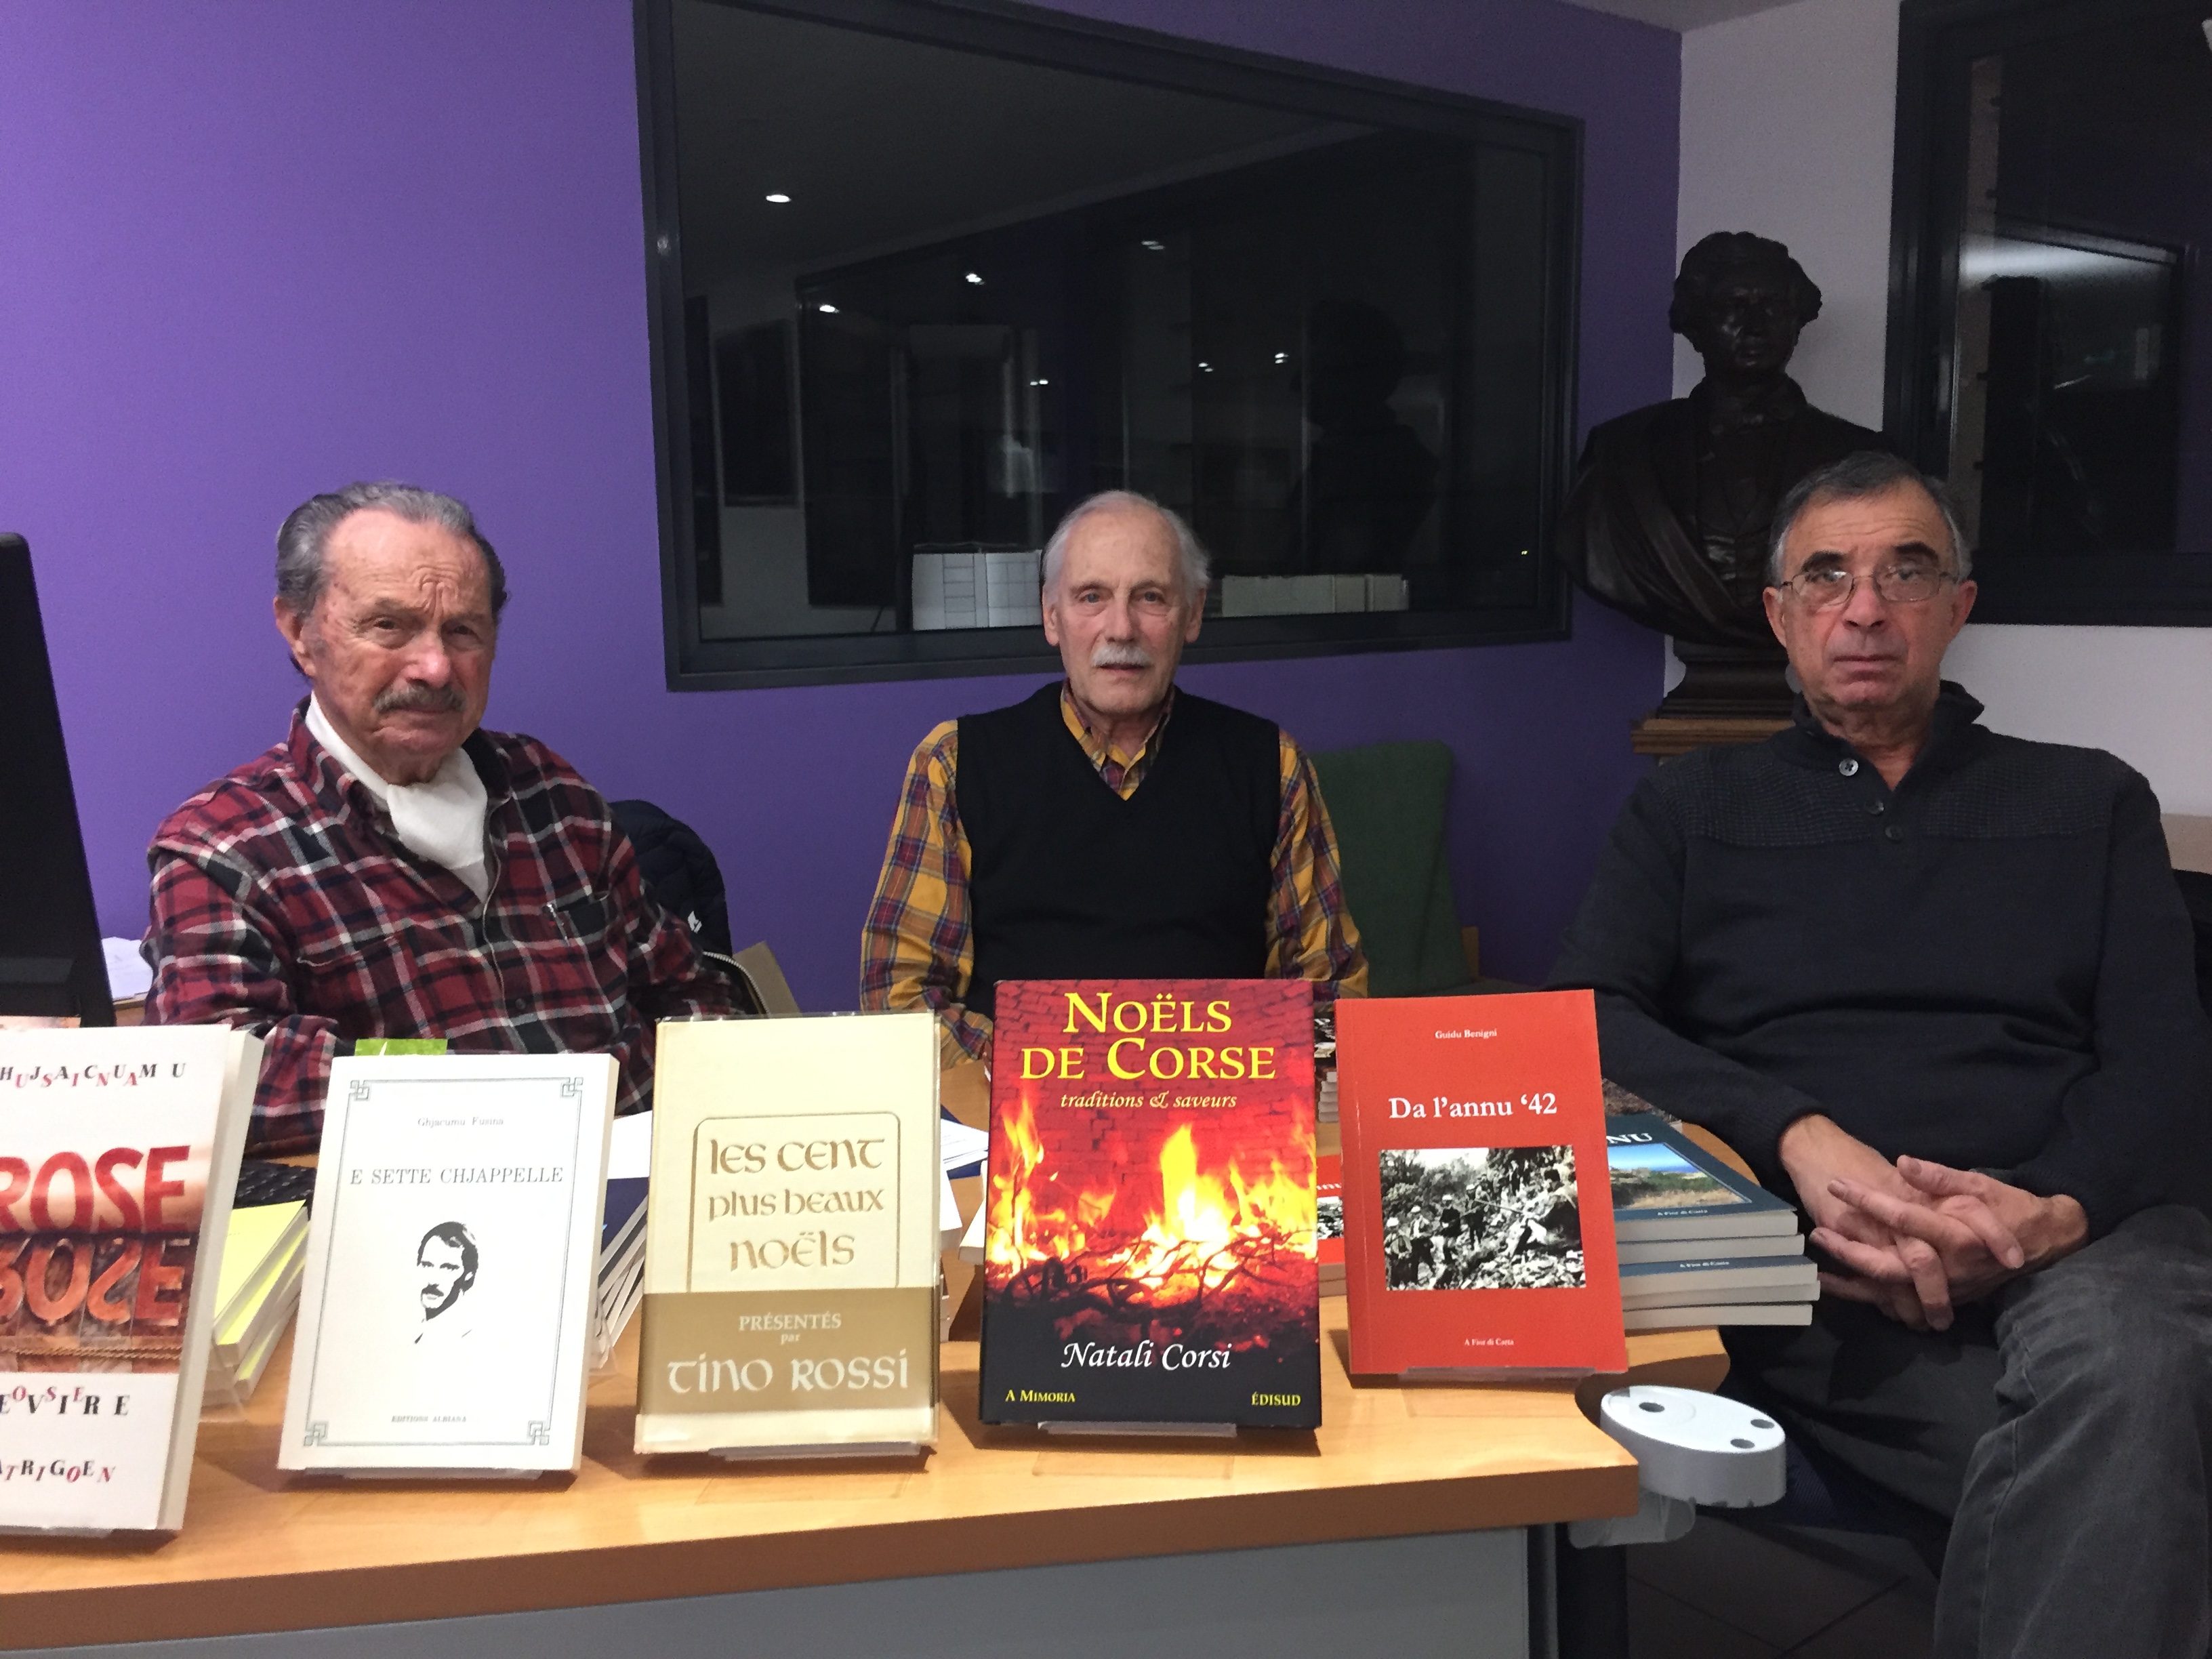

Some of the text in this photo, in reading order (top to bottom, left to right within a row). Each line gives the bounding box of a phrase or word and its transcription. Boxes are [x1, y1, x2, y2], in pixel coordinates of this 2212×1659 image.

[1062, 992, 1233, 1033] NOËLS
[1435, 1028, 1498, 1039] Guidu Benigni
[1020, 1038, 1275, 1080] DE CORSE
[1060, 1091, 1237, 1109] traditions & saveurs
[1388, 1097, 1427, 1120] Da
[350, 1166, 564, 1185] E SETTE CHJAPPELLE
[738, 1310, 842, 1332] PRÉSENTÉS
[780, 1333, 801, 1345] par
[1060, 1339, 1232, 1370] Natali Corsi
[1005, 1389, 1076, 1403] A MIMORIA
[1251, 1391, 1301, 1407] ÉDISUD
